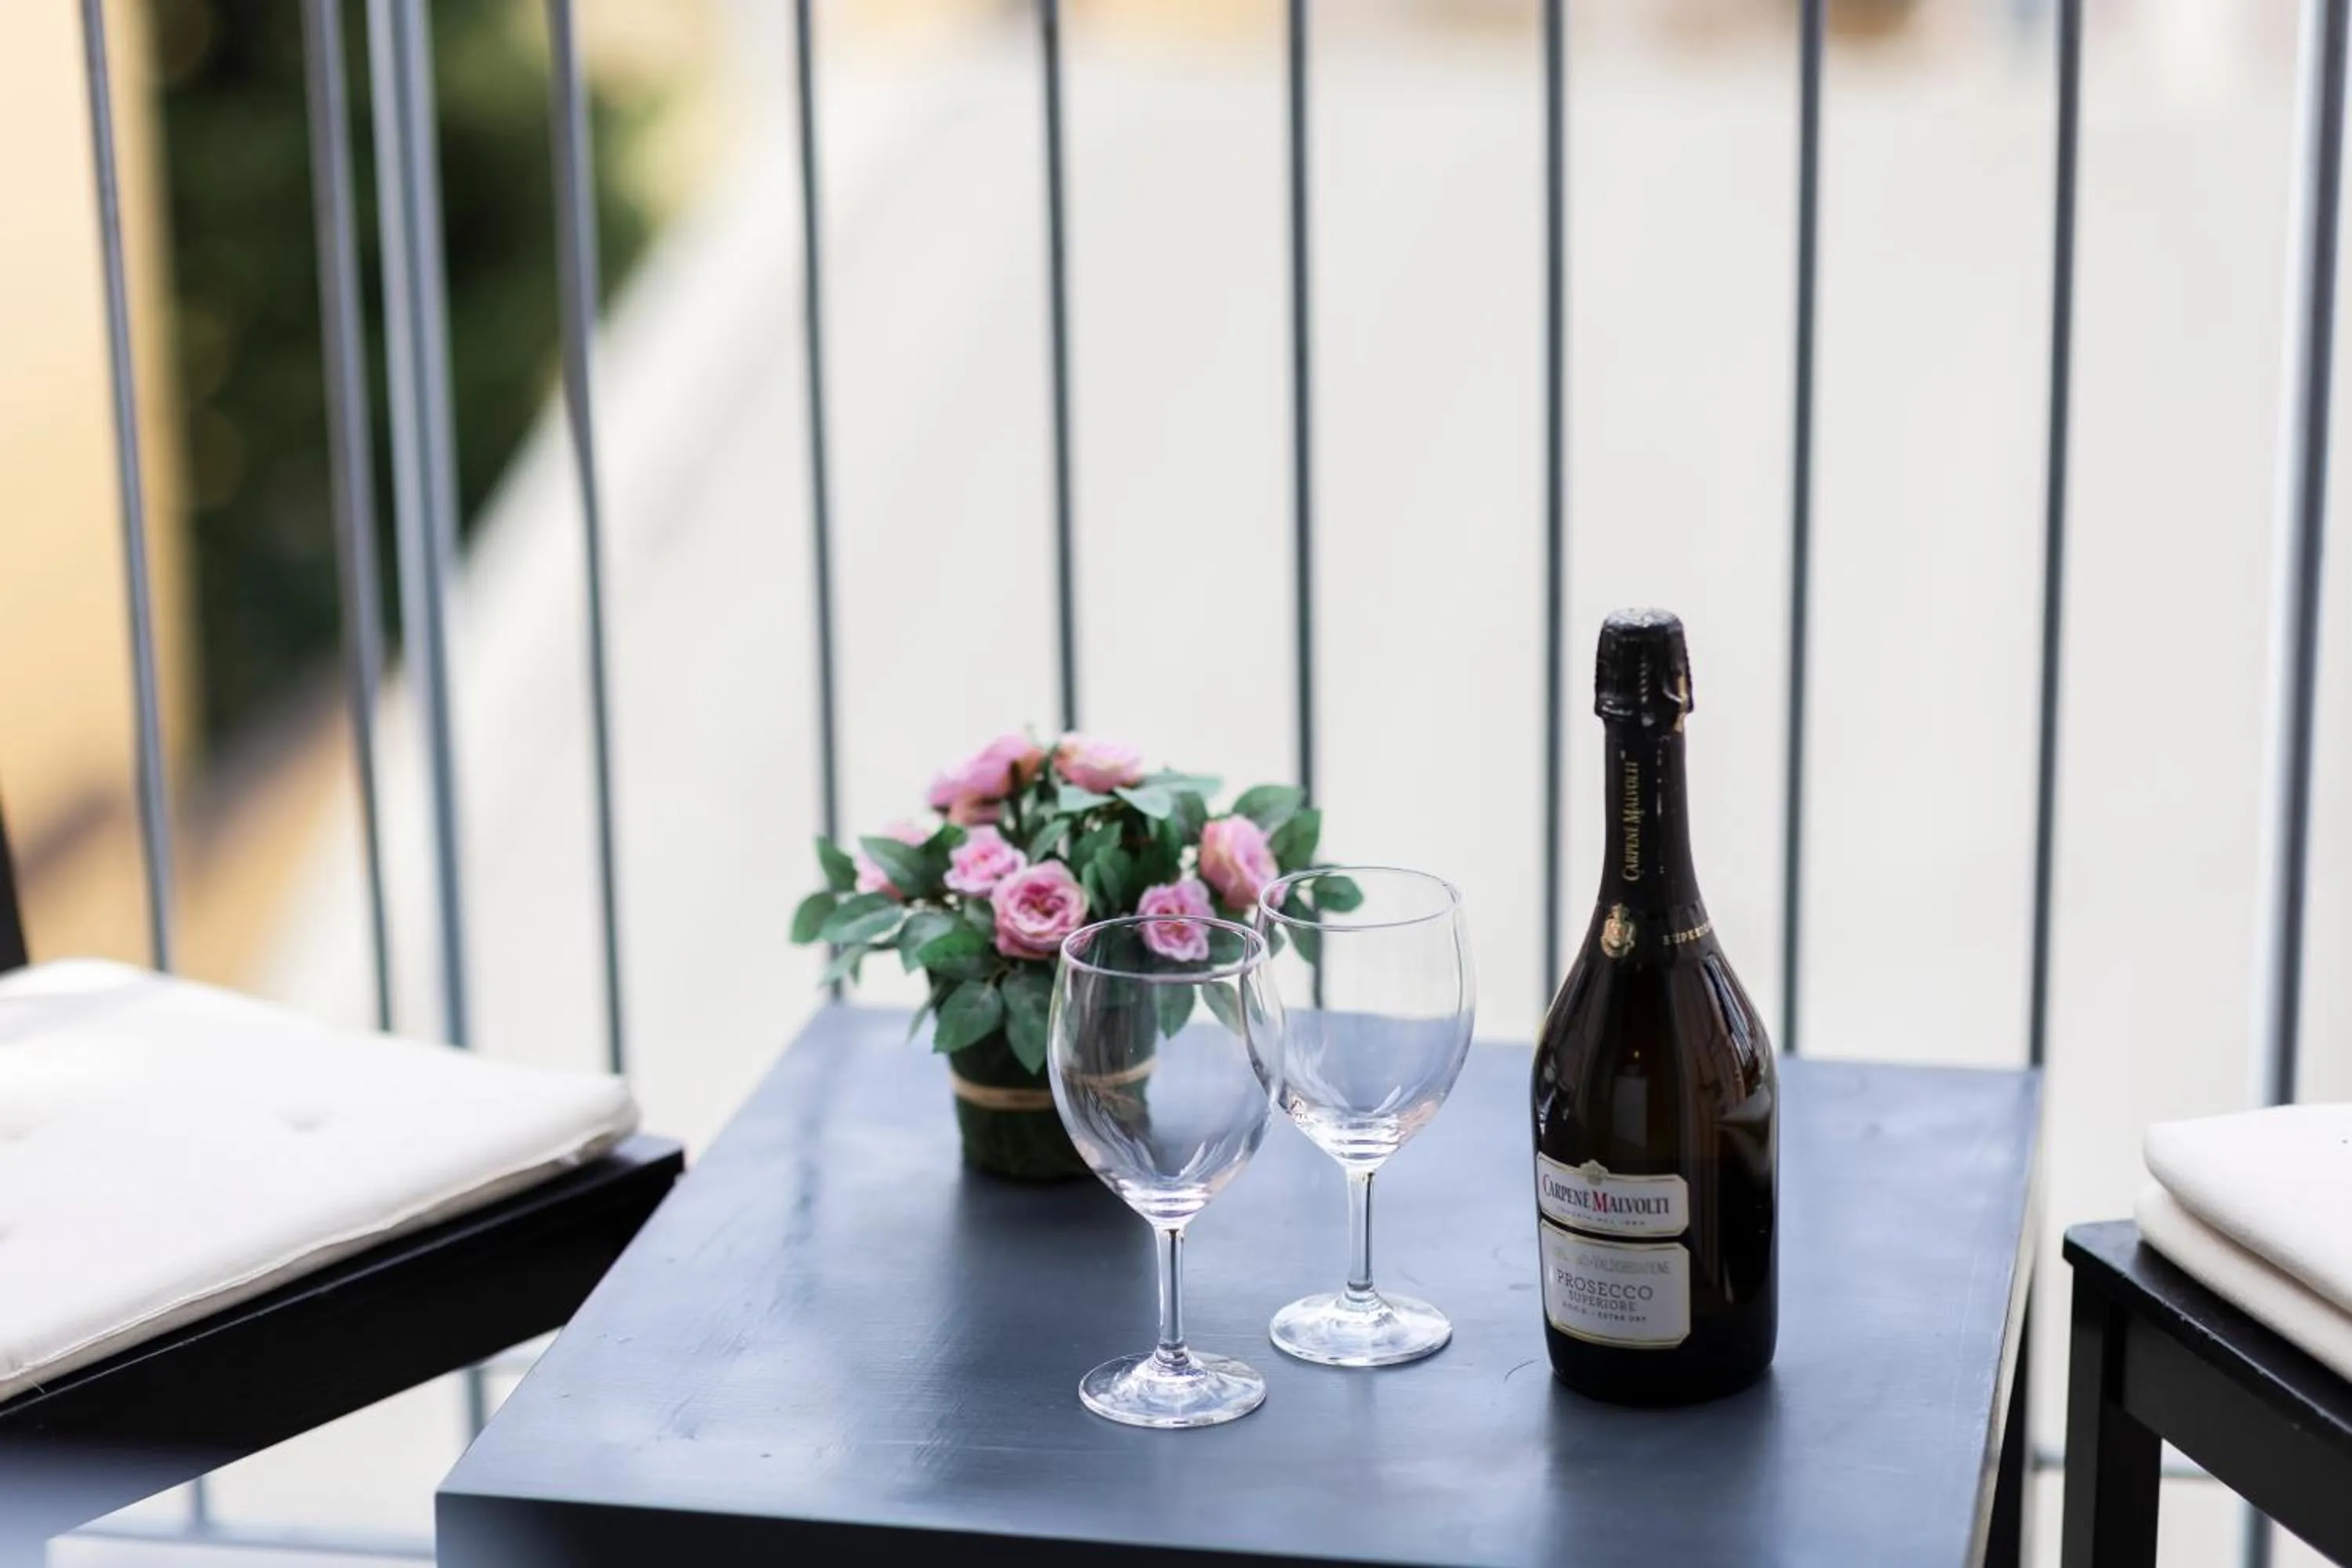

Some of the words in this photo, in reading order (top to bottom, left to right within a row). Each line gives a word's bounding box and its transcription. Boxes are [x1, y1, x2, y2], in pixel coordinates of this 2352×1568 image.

[1592, 1189, 1670, 1214] MALVOLTI
[1556, 1267, 1654, 1301] PROSECCO
[1569, 1289, 1638, 1312] SUPERIORE
